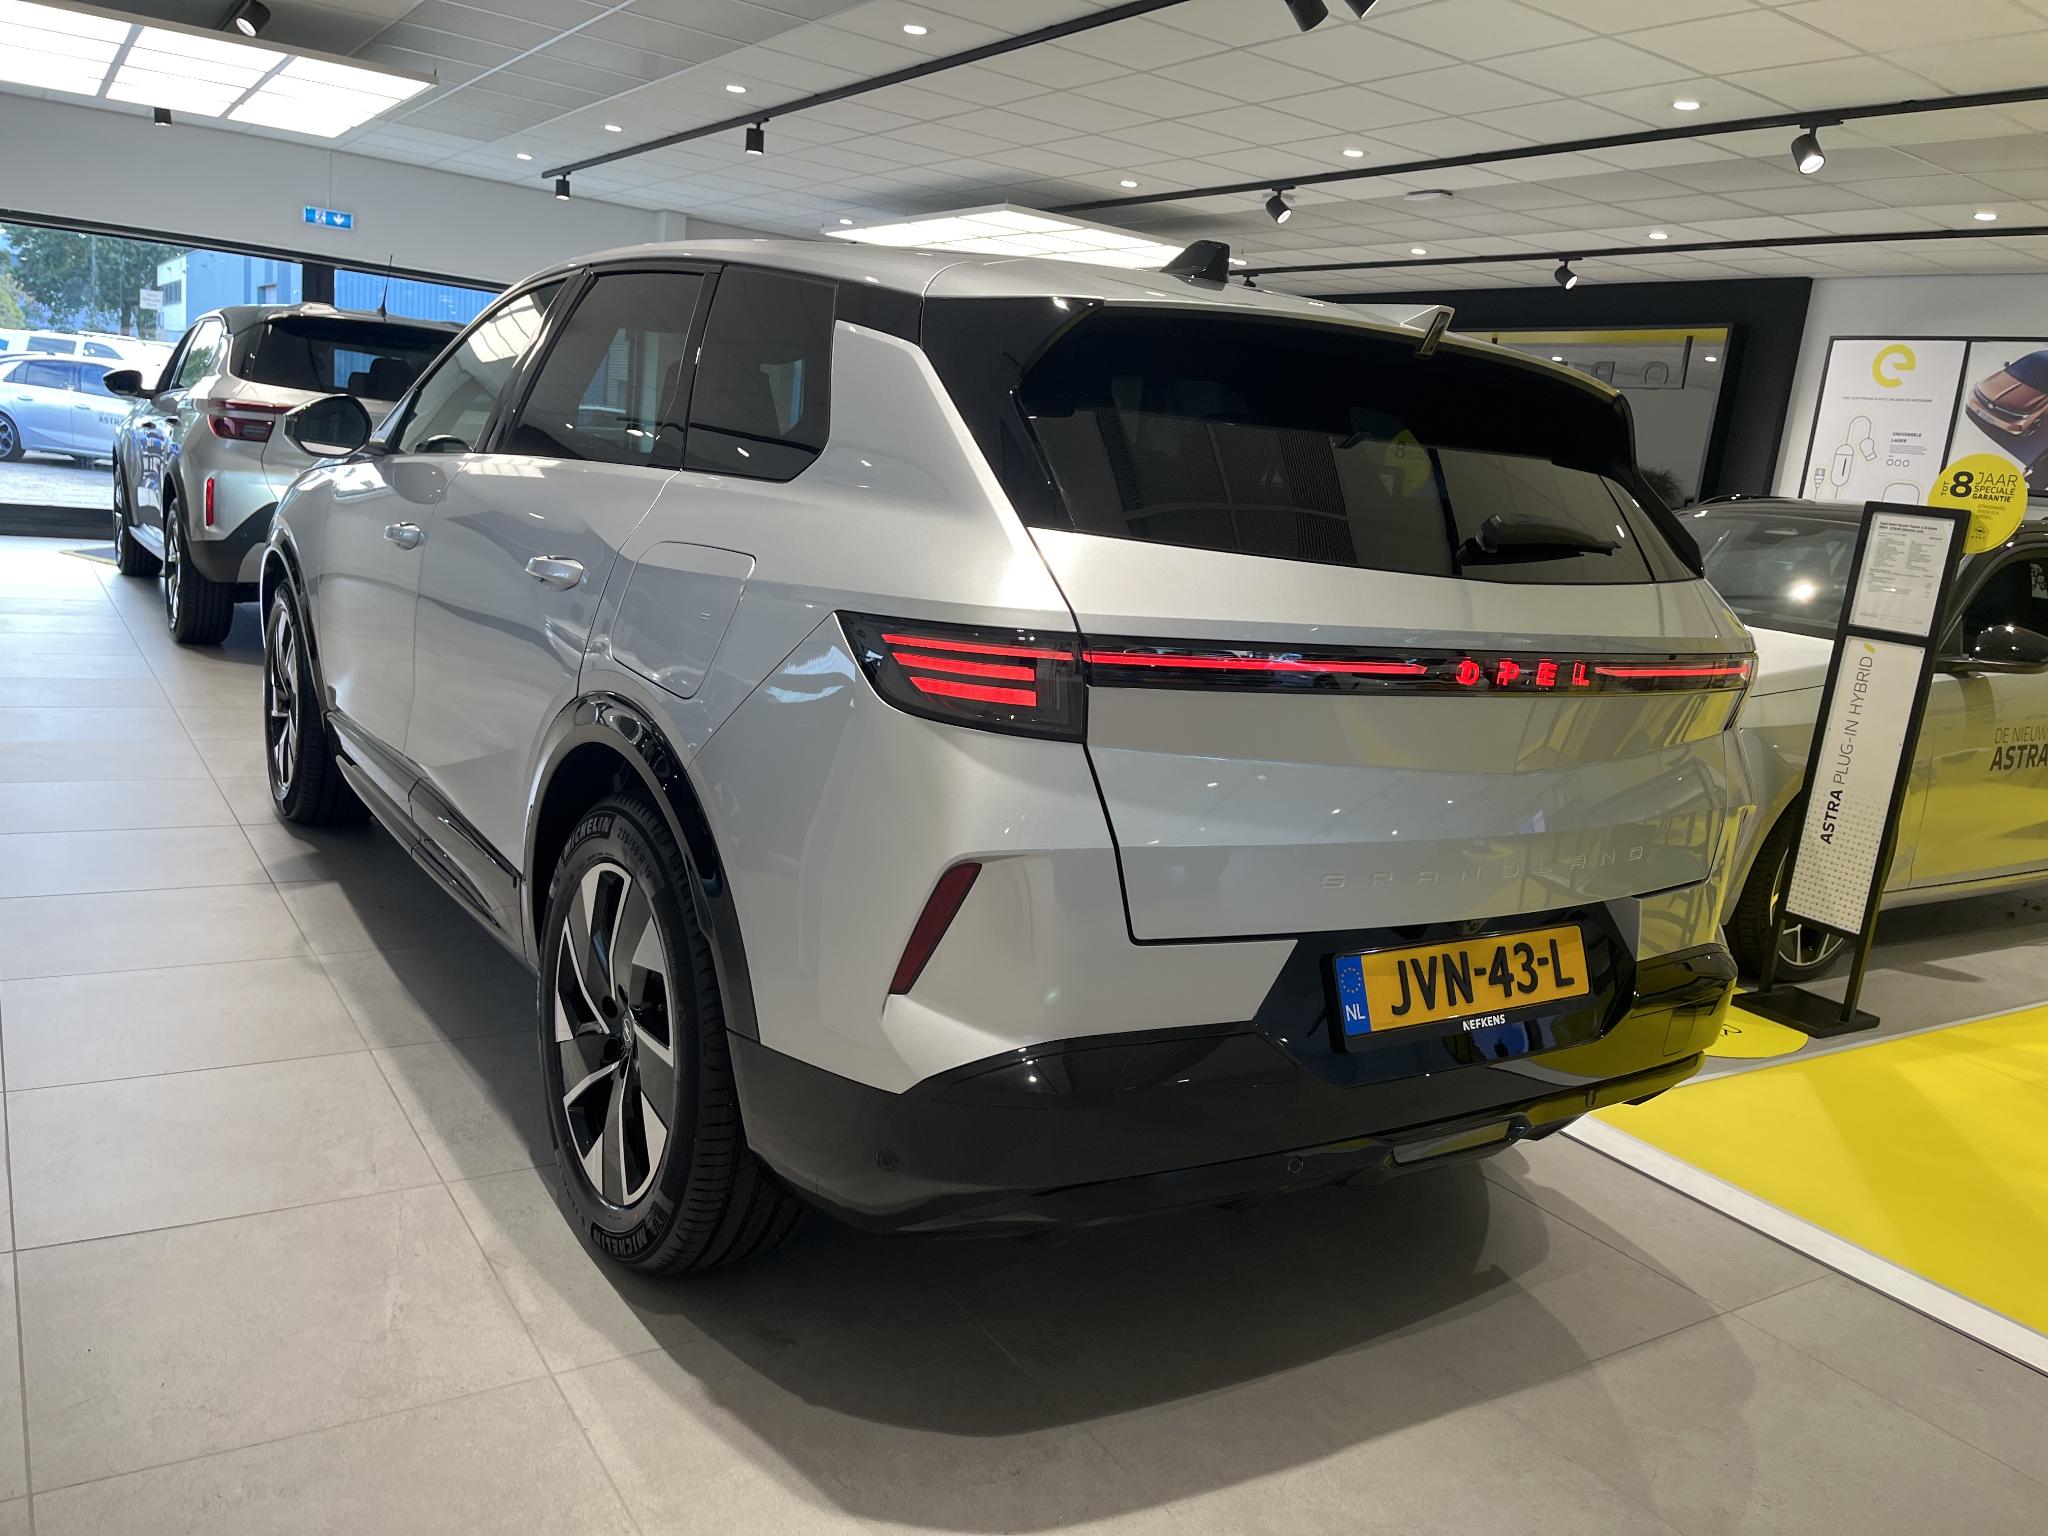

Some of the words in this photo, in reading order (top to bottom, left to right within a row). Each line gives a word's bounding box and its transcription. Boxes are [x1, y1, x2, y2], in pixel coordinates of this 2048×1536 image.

[1941, 481, 1950, 496] TOT
[1949, 471, 1974, 498] 8
[1976, 472, 2018, 487] JAAR
[1974, 485, 2016, 496] SPECIALE
[1972, 493, 2011, 503] GARANTIE
[1455, 660, 1590, 686] OPEL
[1995, 727, 2010, 744] DE
[1820, 789, 1843, 845] ASTRA
[1833, 719, 1860, 785] PLUG-IN
[1848, 655, 1873, 716] HYBRID
[1989, 743, 2048, 771] ASTRA
[1319, 845, 1644, 889] GRANDLAND
[1391, 938, 1575, 1017] JVN-43-L
[1345, 1003, 1366, 1022] NL
[1462, 1013, 1506, 1032] NEFKENS
